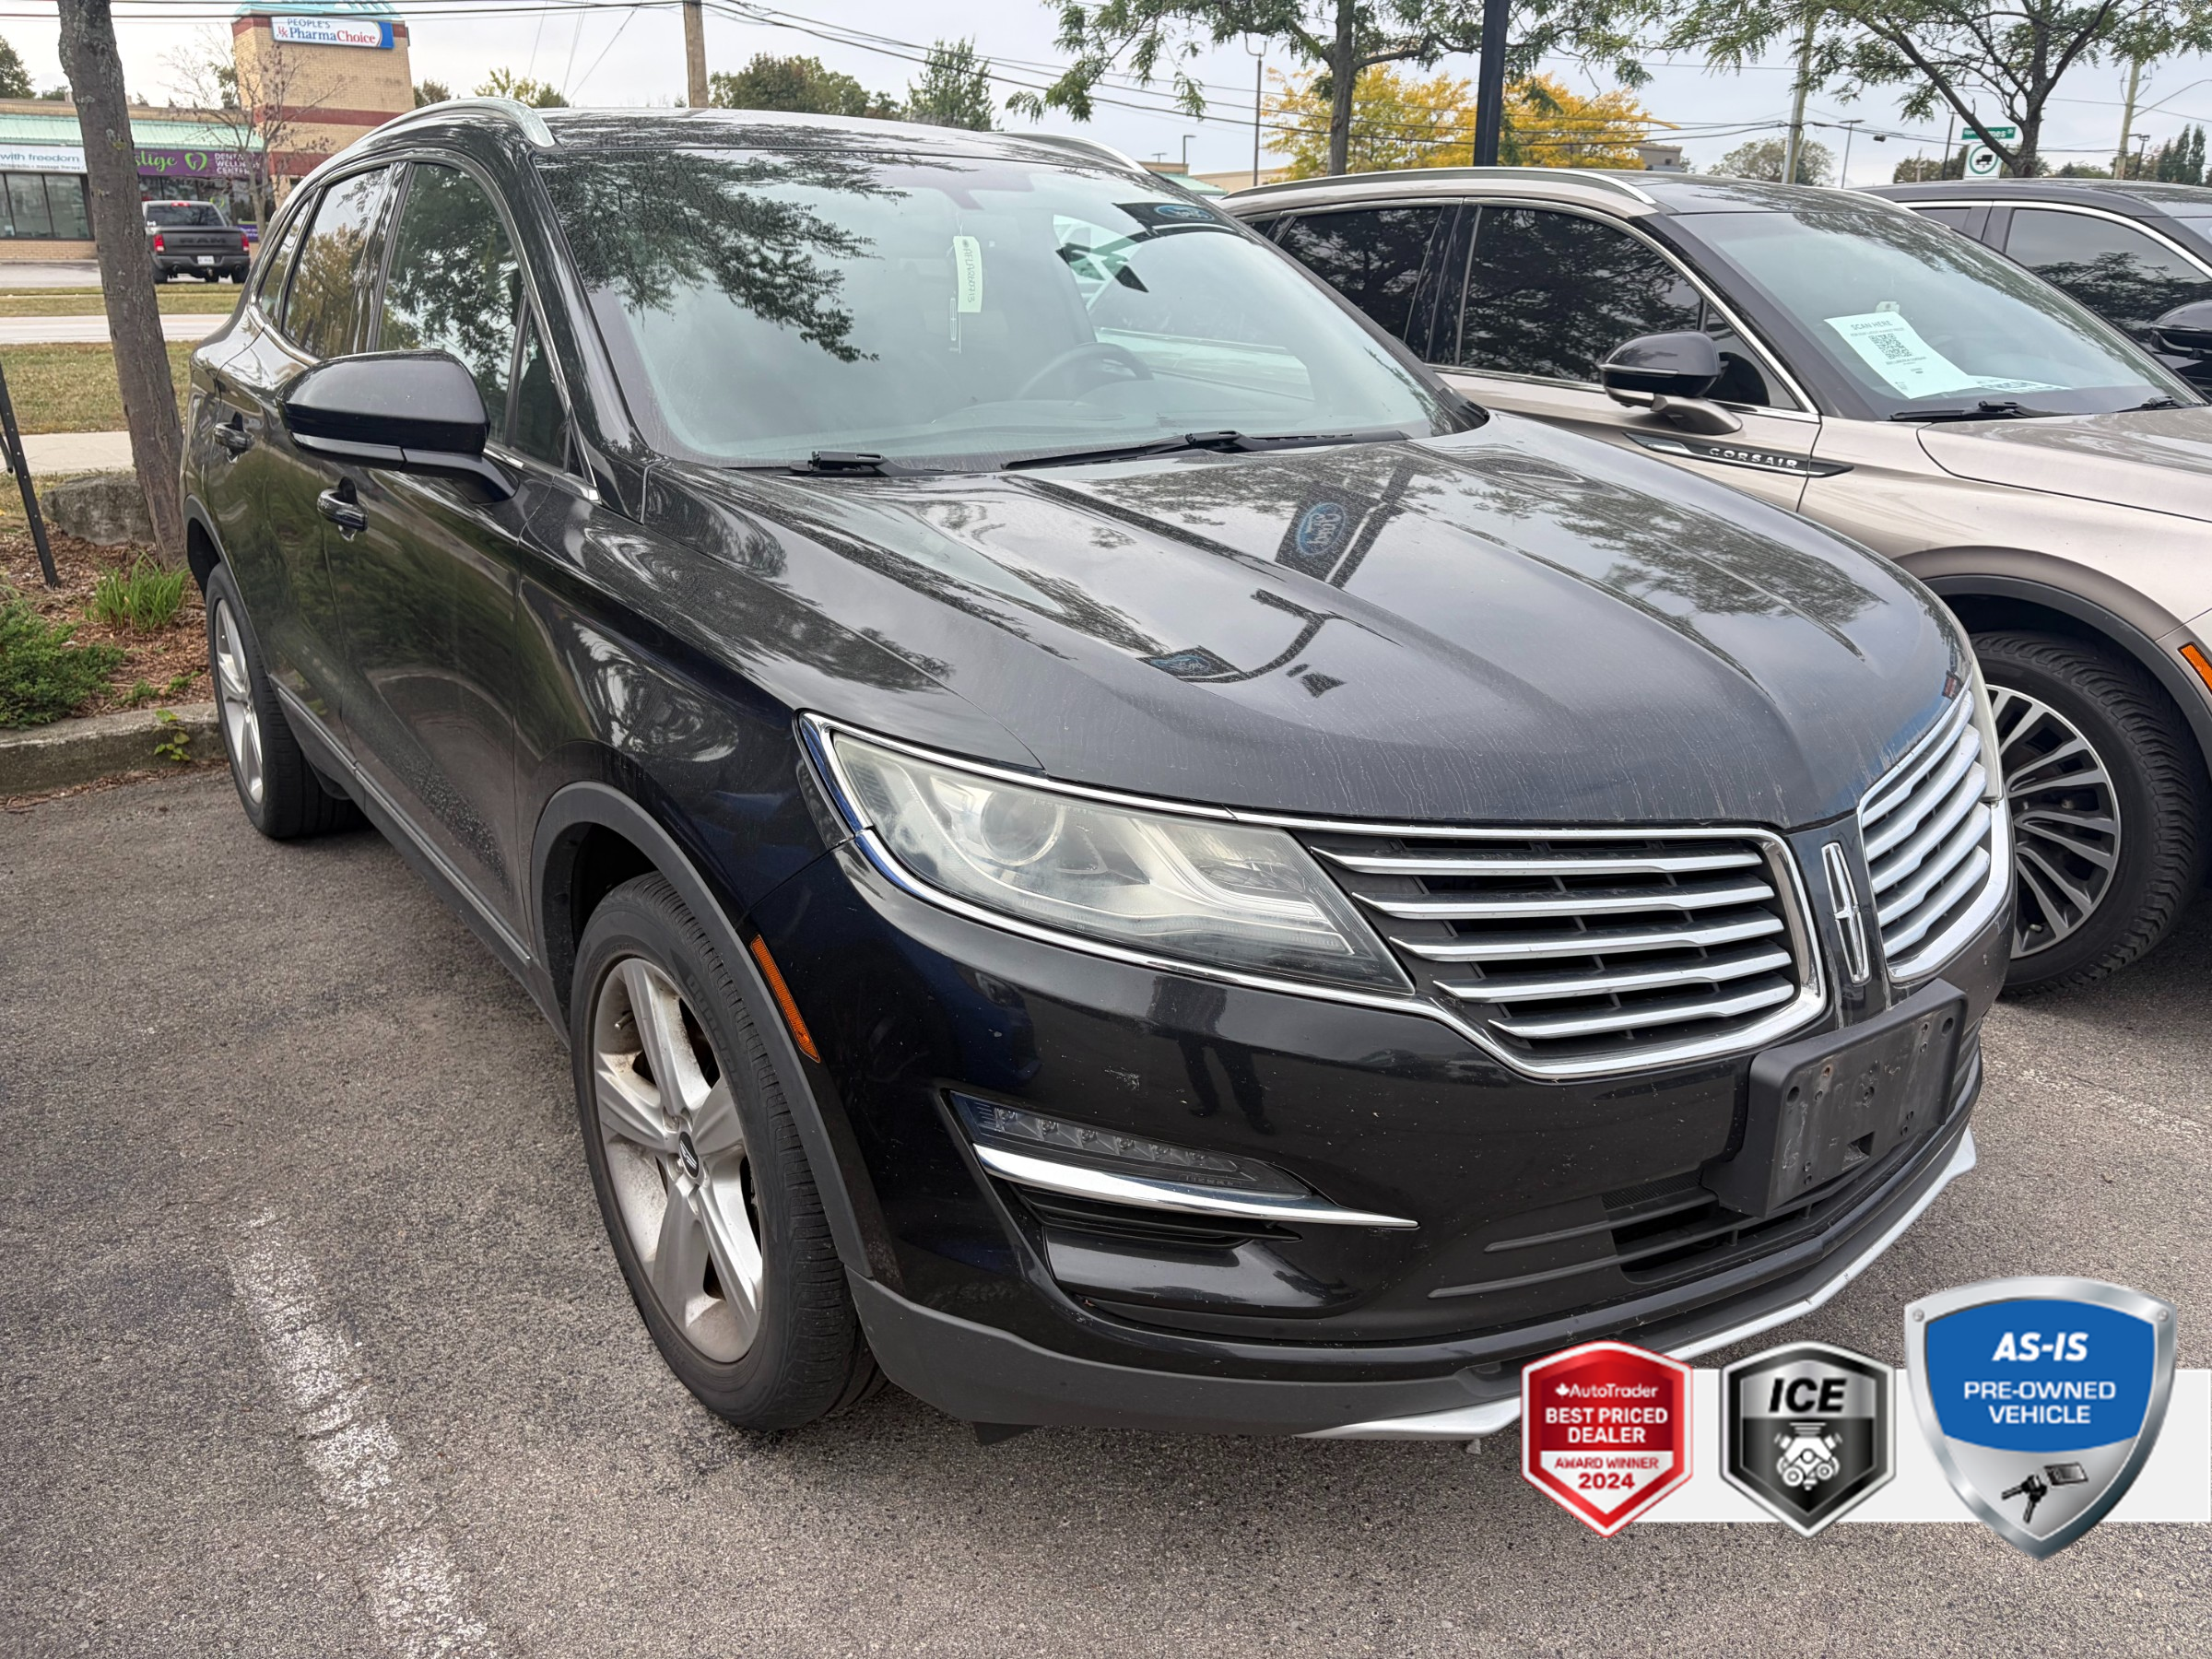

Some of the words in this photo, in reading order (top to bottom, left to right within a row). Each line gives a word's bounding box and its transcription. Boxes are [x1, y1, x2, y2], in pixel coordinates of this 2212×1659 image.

[288, 18, 331, 29] PEOPLE'S
[289, 27, 376, 43] PharmaChoice
[29, 153, 79, 162] freedom
[215, 152, 244, 160] DENTA
[1873, 320, 1893, 328] HERE
[1709, 448, 1798, 469] CORSAIR
